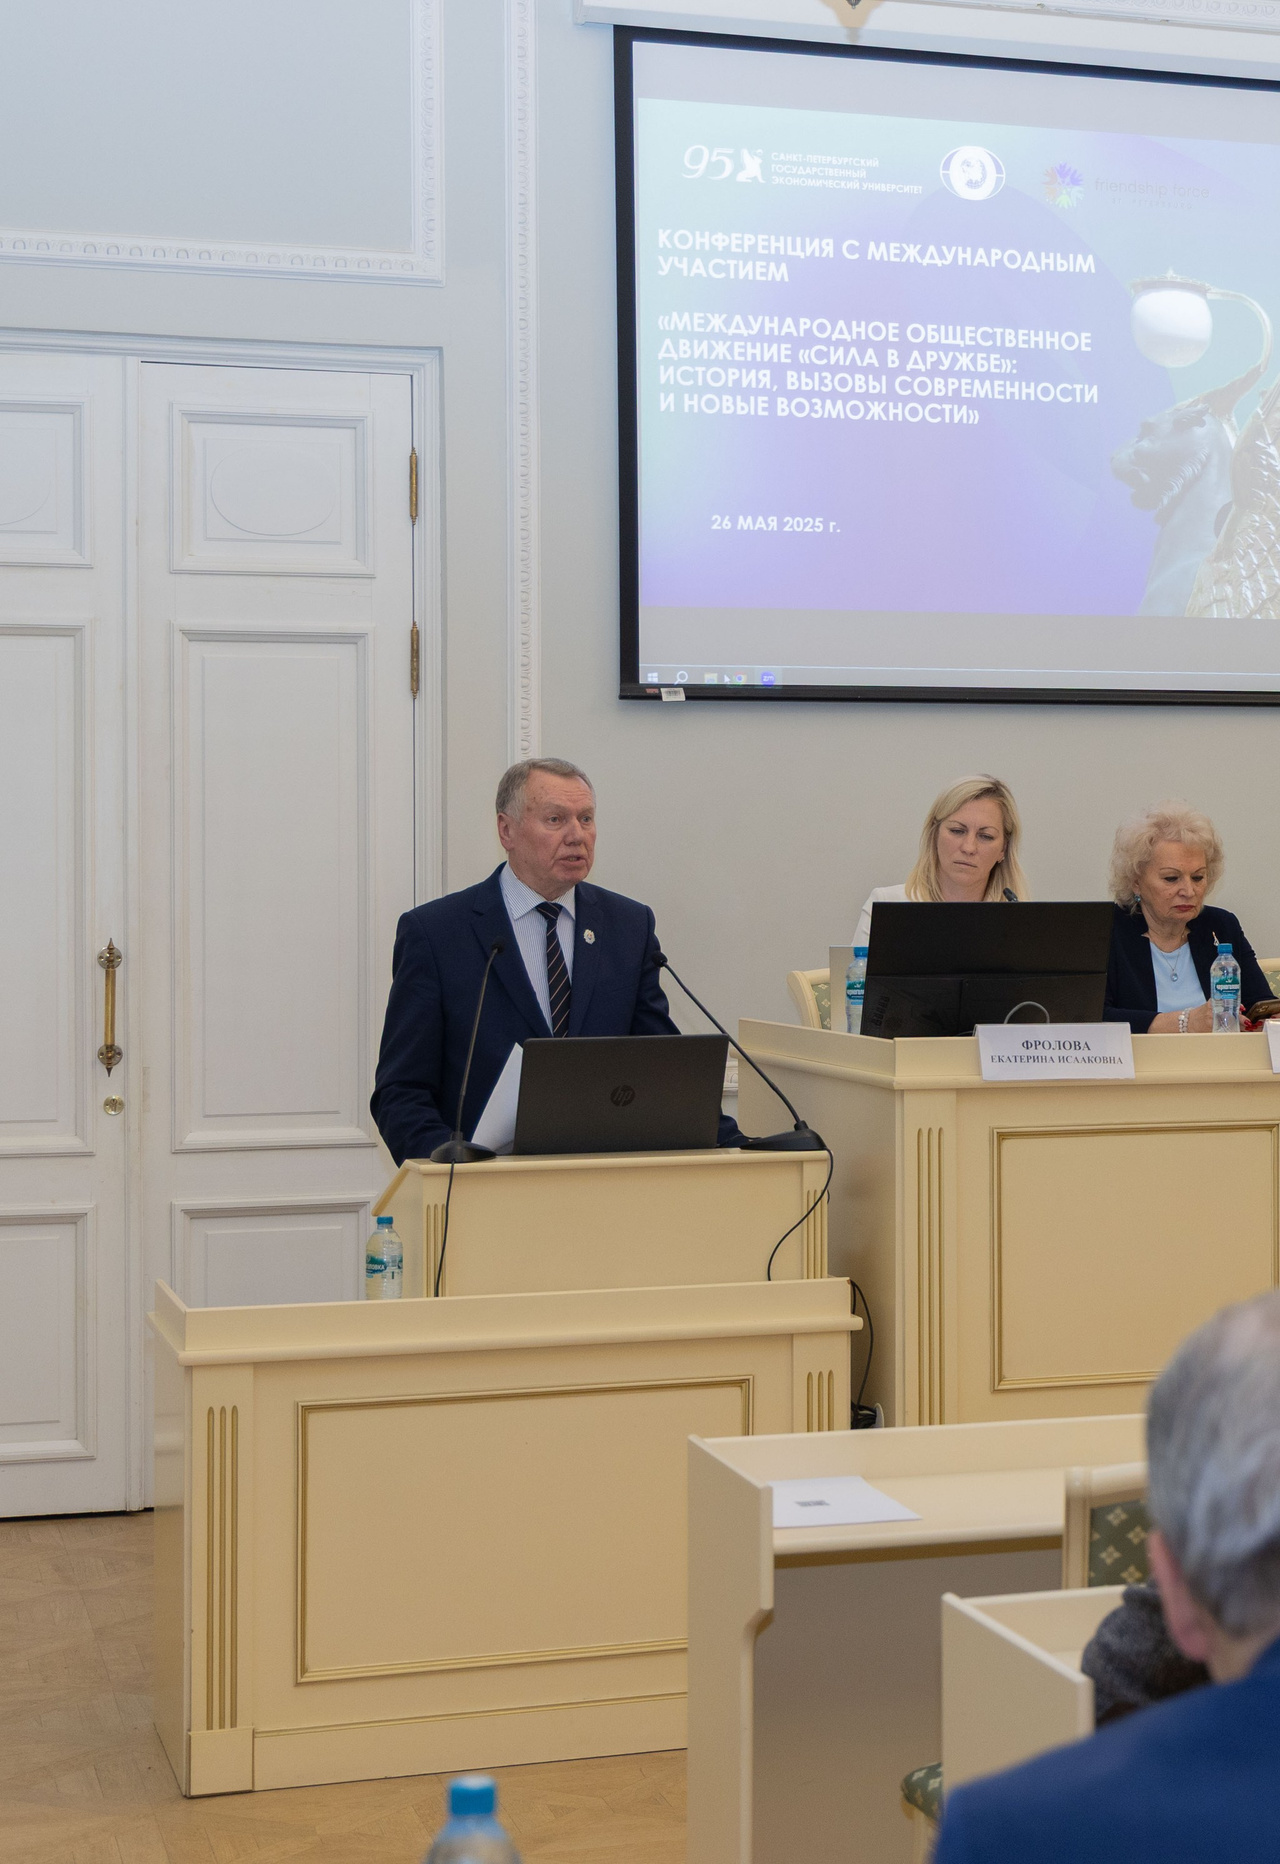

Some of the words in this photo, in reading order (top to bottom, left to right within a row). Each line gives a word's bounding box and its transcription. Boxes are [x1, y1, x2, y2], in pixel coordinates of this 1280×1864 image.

[681, 145, 735, 180] 95
[771, 152, 879, 167] САНКТ-ПЕТЕРБУРГСКИЙ
[771, 164, 867, 179] ГОСУДАРСТВЕННЫЙ
[771, 176, 860, 190] ЭКОНОМИЧЕСКИЙ
[862, 182, 922, 194] УНИВЕРСИТЕТ
[1095, 178, 1168, 198] friendship
[658, 229, 834, 259] КОНФЕРЕНЦИЯ
[842, 240, 860, 259] С
[867, 241, 1095, 274] МЕЖДУНАРОДНЫМ
[658, 256, 789, 282] УЧАСТИЕМ
[658, 312, 899, 343] «МЕЖДУНАРОДНОЕ
[907, 323, 1092, 352] ОБЩЕСТВЕННОЕ
[658, 338, 791, 364] ДВИЖЕНИЕ
[799, 345, 878, 367] «СИЛА
[888, 348, 899, 368] В
[906, 349, 1017, 375] ДРУЖБЕ»:
[659, 365, 779, 391] ИСТОРИЯ,
[787, 372, 887, 394] ВЫЗОВЫ
[894, 376, 1099, 404] СОВРЕМЕННОСТИ
[659, 392, 675, 412] И
[683, 393, 769, 416] НОВЫЕ
[776, 397, 980, 425] ВОЗМОЖНОСТИ»
[711, 515, 731, 530] 26
[737, 515, 777, 531] МАЯ
[783, 517, 824, 533] 2025
[829, 521, 841, 533] г.
[1022, 1040, 1091, 1051] ФРОЛОВА
[991, 1055, 1055, 1064] ЕКАТЕРИНА
[1058, 1056, 1123, 1065] ИСААКОВНА
[612, 1085, 634, 1106] hp
